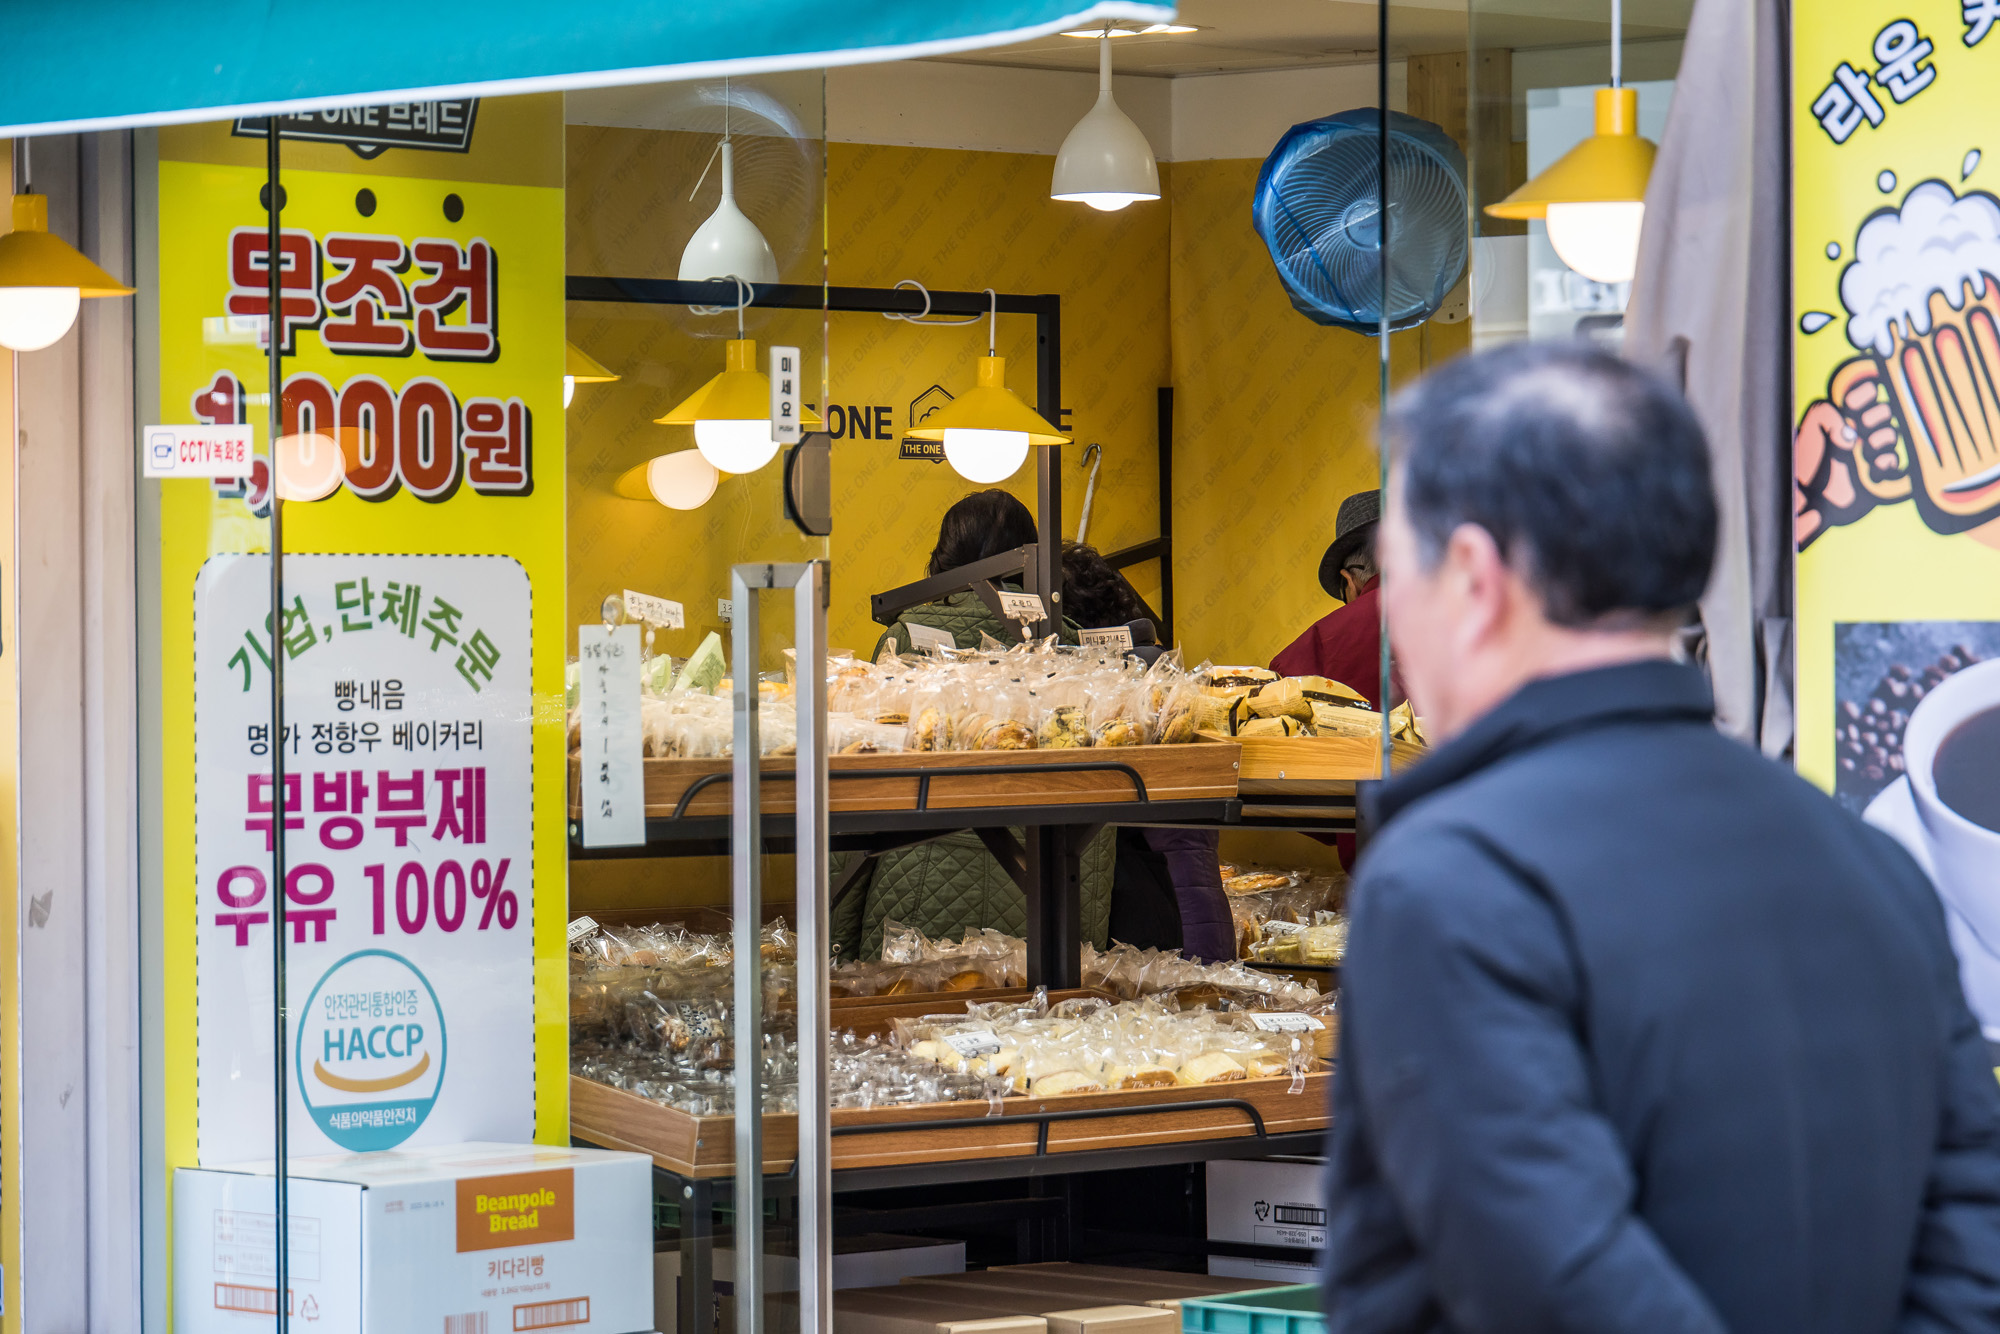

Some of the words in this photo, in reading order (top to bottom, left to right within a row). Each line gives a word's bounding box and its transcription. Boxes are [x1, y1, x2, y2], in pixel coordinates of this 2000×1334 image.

[225, 226, 499, 362] 무조건
[781, 357, 792, 417] 미세요
[827, 404, 893, 440] ONE
[905, 444, 922, 454] THE
[923, 444, 941, 455] ONE
[334, 678, 406, 711] 빵내음
[311, 720, 381, 754] 정항우
[392, 719, 484, 752] 베이커리
[245, 766, 486, 852] 무방부제
[215, 862, 337, 946] 우유
[363, 857, 518, 936] 100%
[324, 989, 419, 1020] 안전관리통합인증
[323, 1022, 425, 1062] HACCP
[329, 1107, 417, 1129] 식품의약품안전처
[475, 1187, 556, 1214] Beanpole
[489, 1209, 539, 1233] Bread
[487, 1254, 545, 1280] 키다리빵
